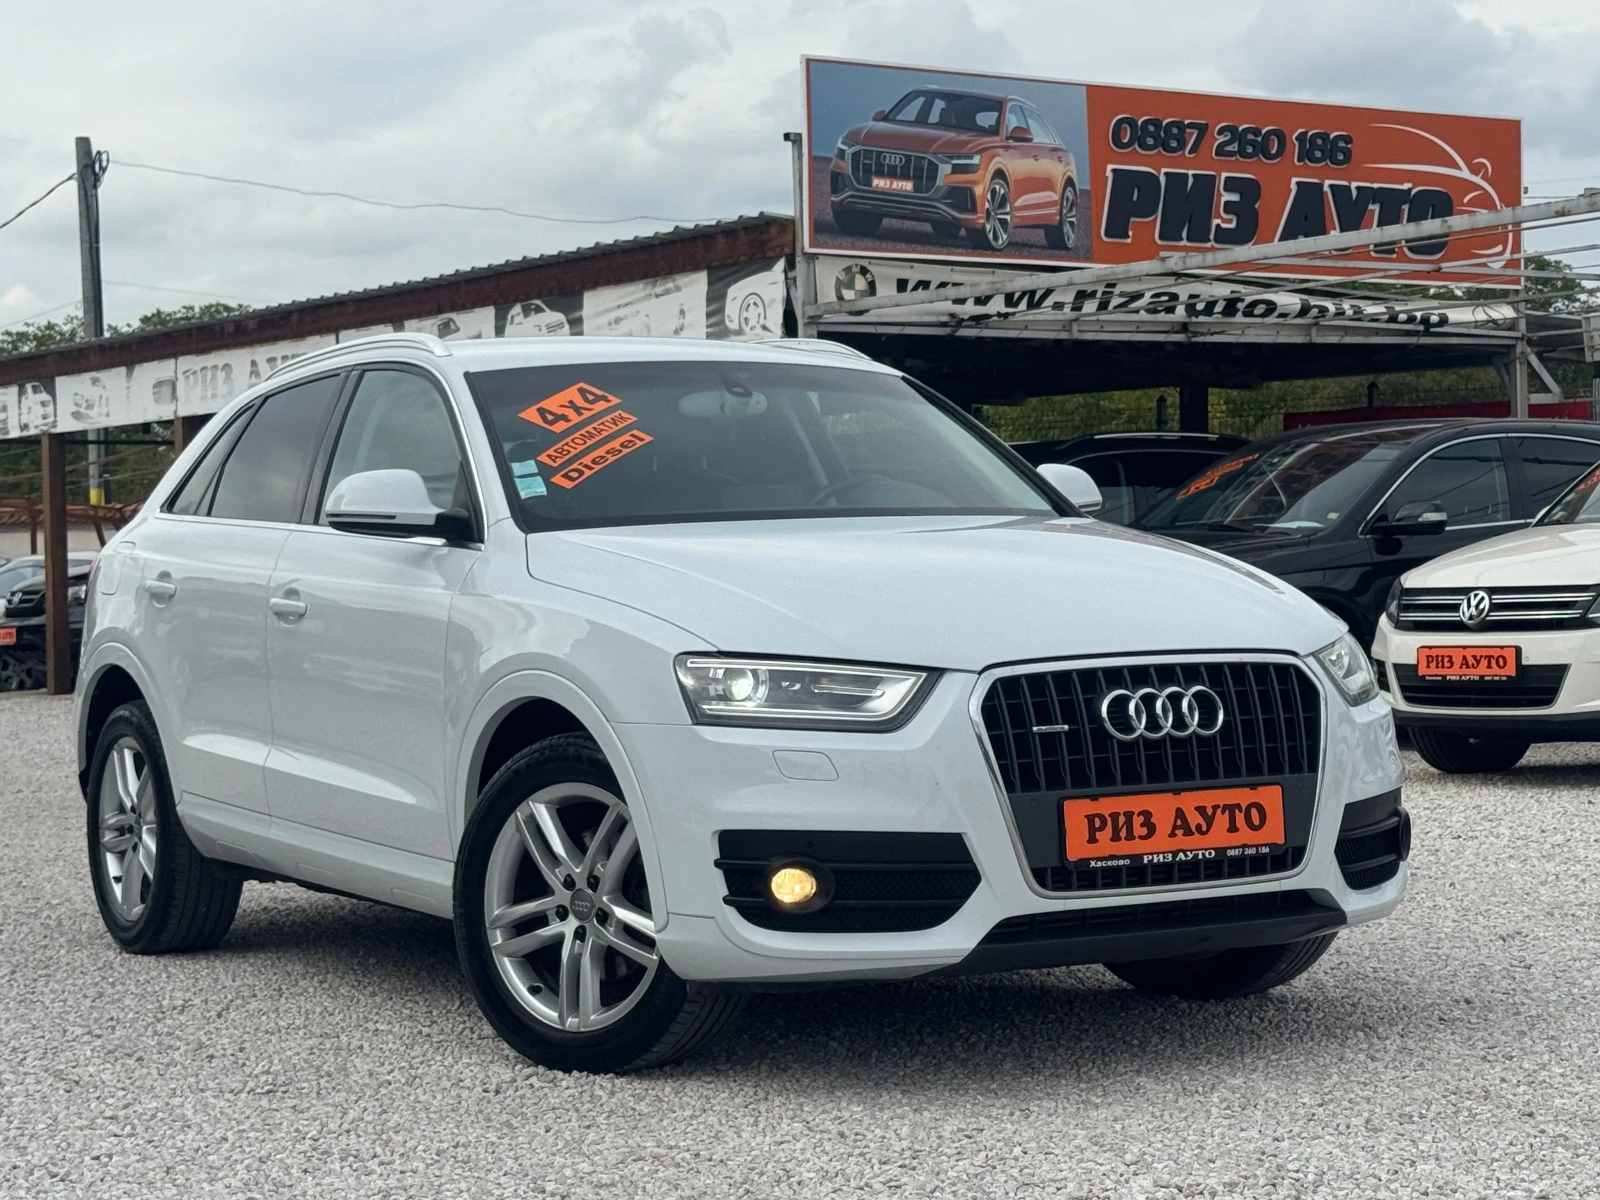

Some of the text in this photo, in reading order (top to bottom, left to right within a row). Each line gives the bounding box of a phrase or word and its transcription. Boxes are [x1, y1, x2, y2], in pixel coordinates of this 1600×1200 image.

[1109, 114, 1354, 168] 0887 260 186
[872, 179, 913, 190] РИЗ АУТО
[1101, 164, 1455, 260] РИЗ АУТО
[536, 386, 612, 427] 4x4
[546, 413, 632, 464] АВТОМАТИК
[560, 433, 646, 483] Diesel
[1425, 654, 1507, 669] РИЗ АУТО
[1085, 801, 1268, 845] РИЗ АУТО
[1089, 858, 1131, 868] Хасково
[1143, 849, 1216, 864] РИЗ АУТО
